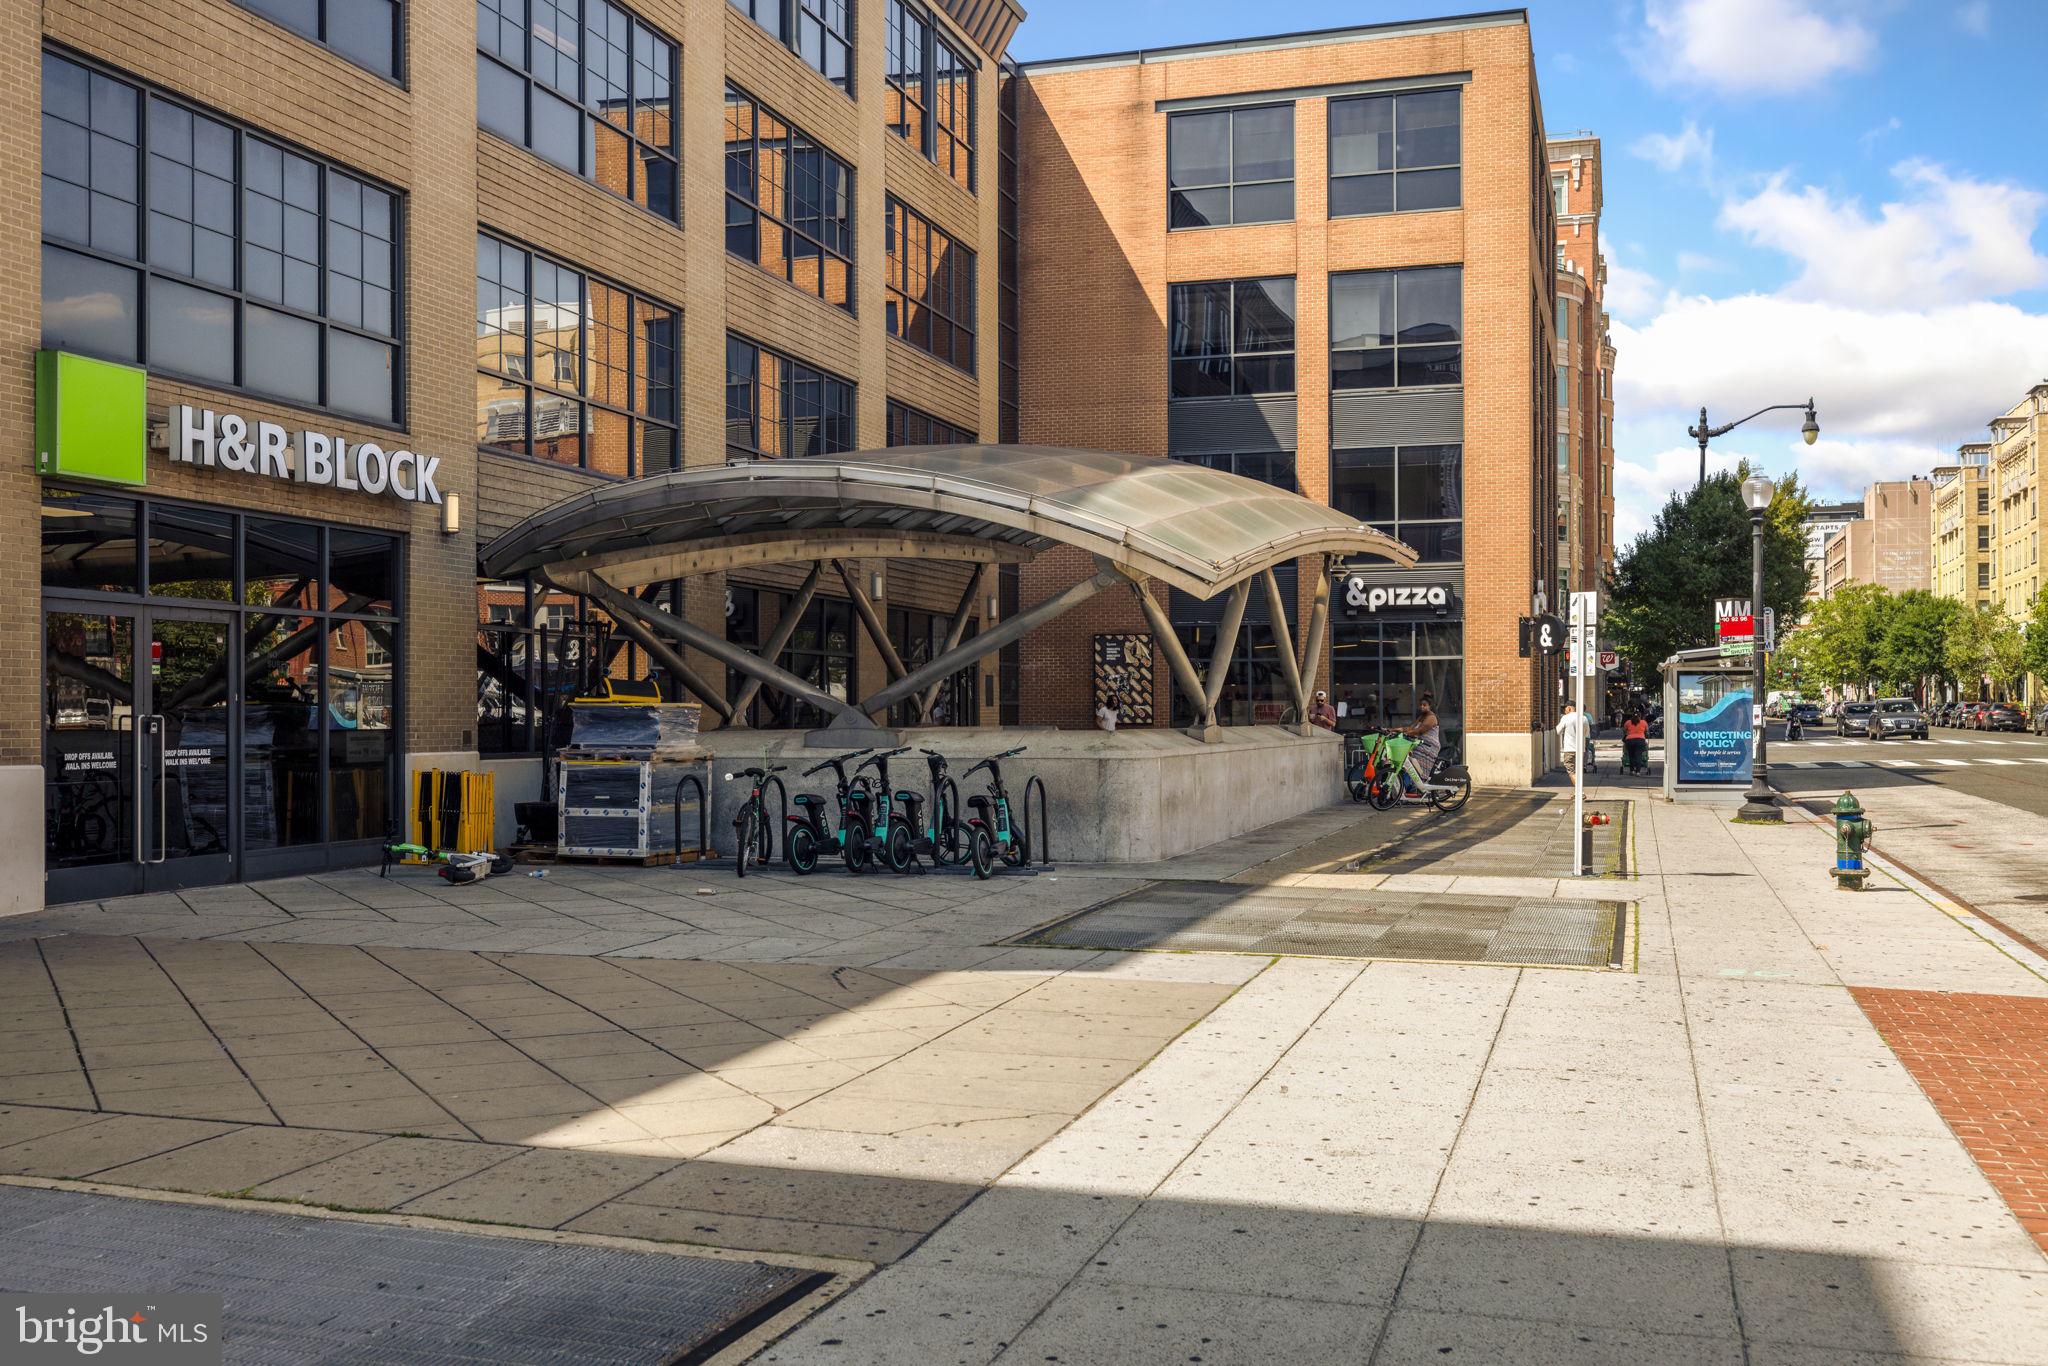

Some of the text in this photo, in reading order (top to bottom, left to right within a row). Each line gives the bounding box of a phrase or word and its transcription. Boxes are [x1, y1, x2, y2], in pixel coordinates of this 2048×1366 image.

[177, 404, 443, 504] H&R BLOCK
[1346, 577, 1446, 612] &pizza
[1540, 623, 1552, 647] &
[1683, 731, 1752, 740] CONNECTING
[1698, 740, 1736, 748] POLICY
[64, 753, 78, 761] DROP
[78, 752, 91, 760] OFFS
[165, 748, 211, 757] DROP OFFS AVAILABLE
[80, 762, 91, 770] INS
[91, 761, 117, 769] WELCOME
[165, 758, 179, 766] WALK
